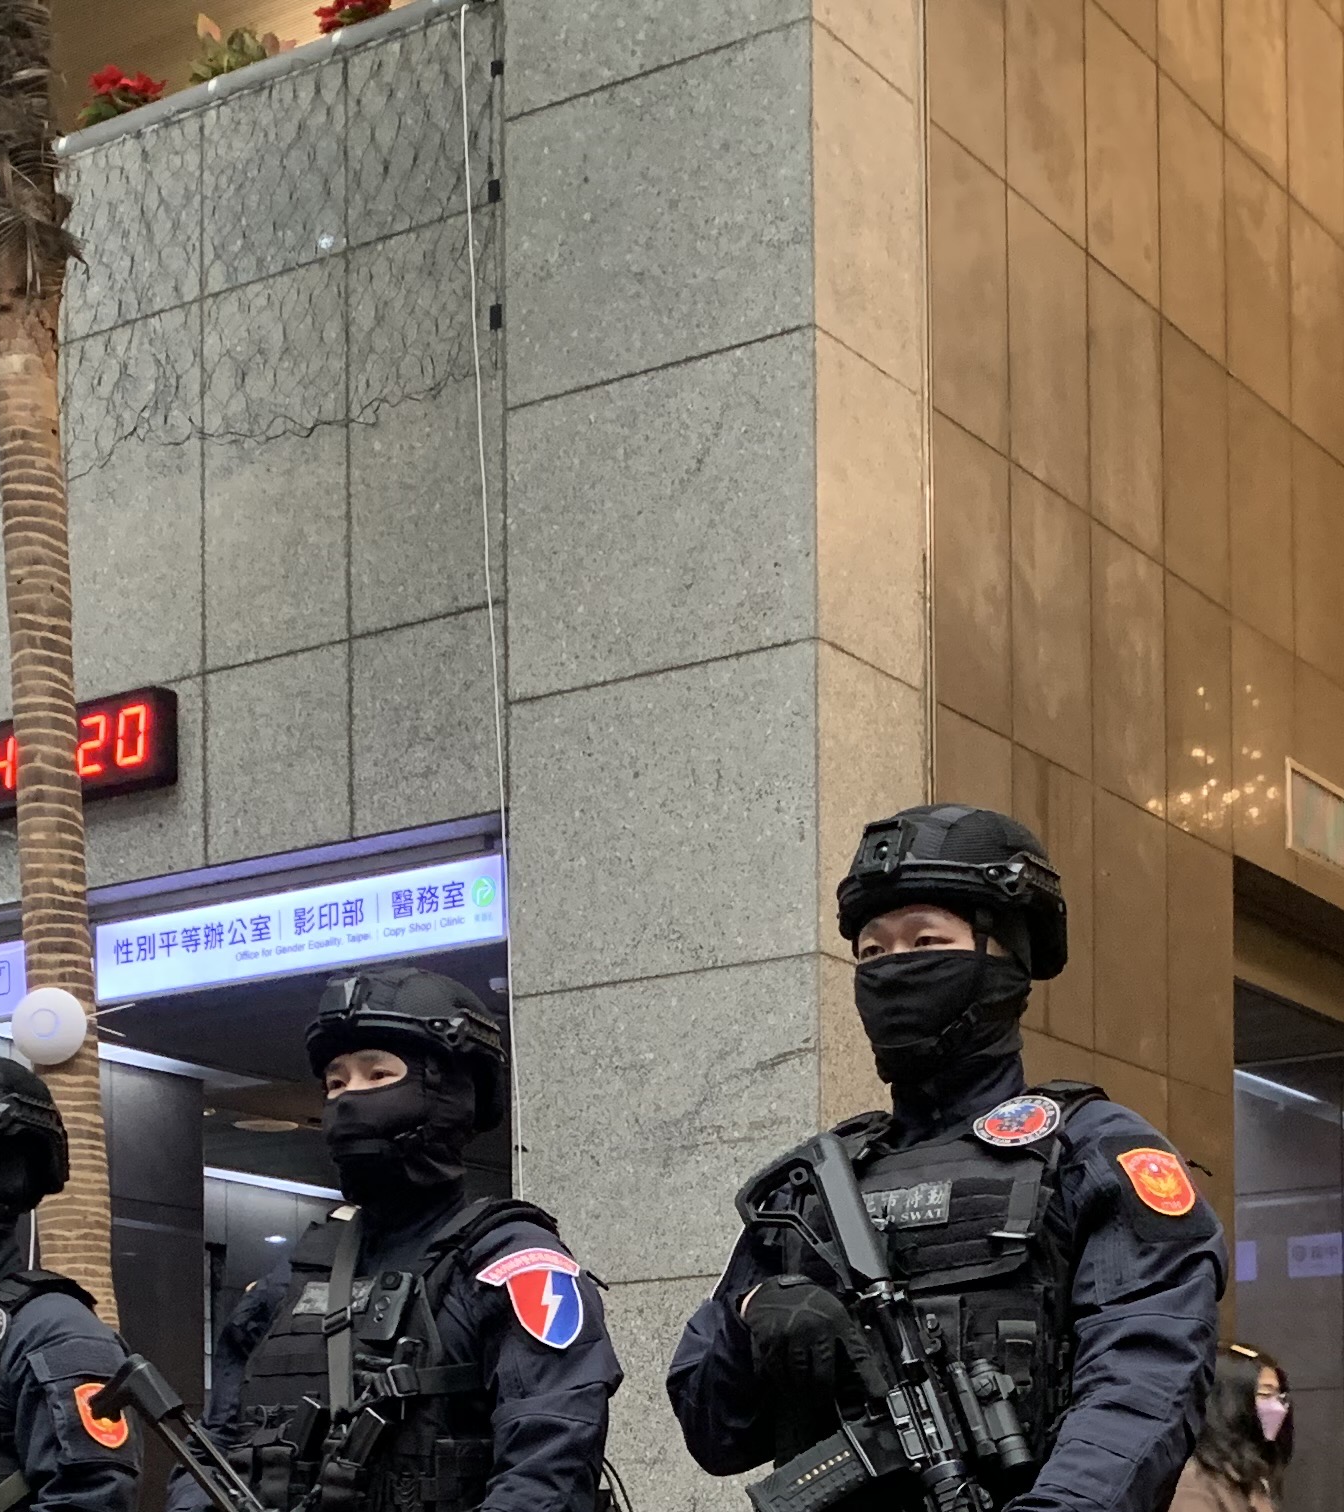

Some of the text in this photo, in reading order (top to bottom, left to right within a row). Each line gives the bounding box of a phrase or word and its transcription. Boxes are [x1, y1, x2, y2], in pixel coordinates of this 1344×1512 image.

[113, 881, 465, 965] 性別平等辦公室 影印部 醫務室
[236, 949, 260, 961] Office
[261, 948, 273, 957] for
[275, 942, 306, 956] Gender
[384, 926, 405, 938] Copy
[409, 922, 432, 934] Shop
[440, 916, 465, 928] Clinic
[900, 1208, 943, 1223] SWAT
